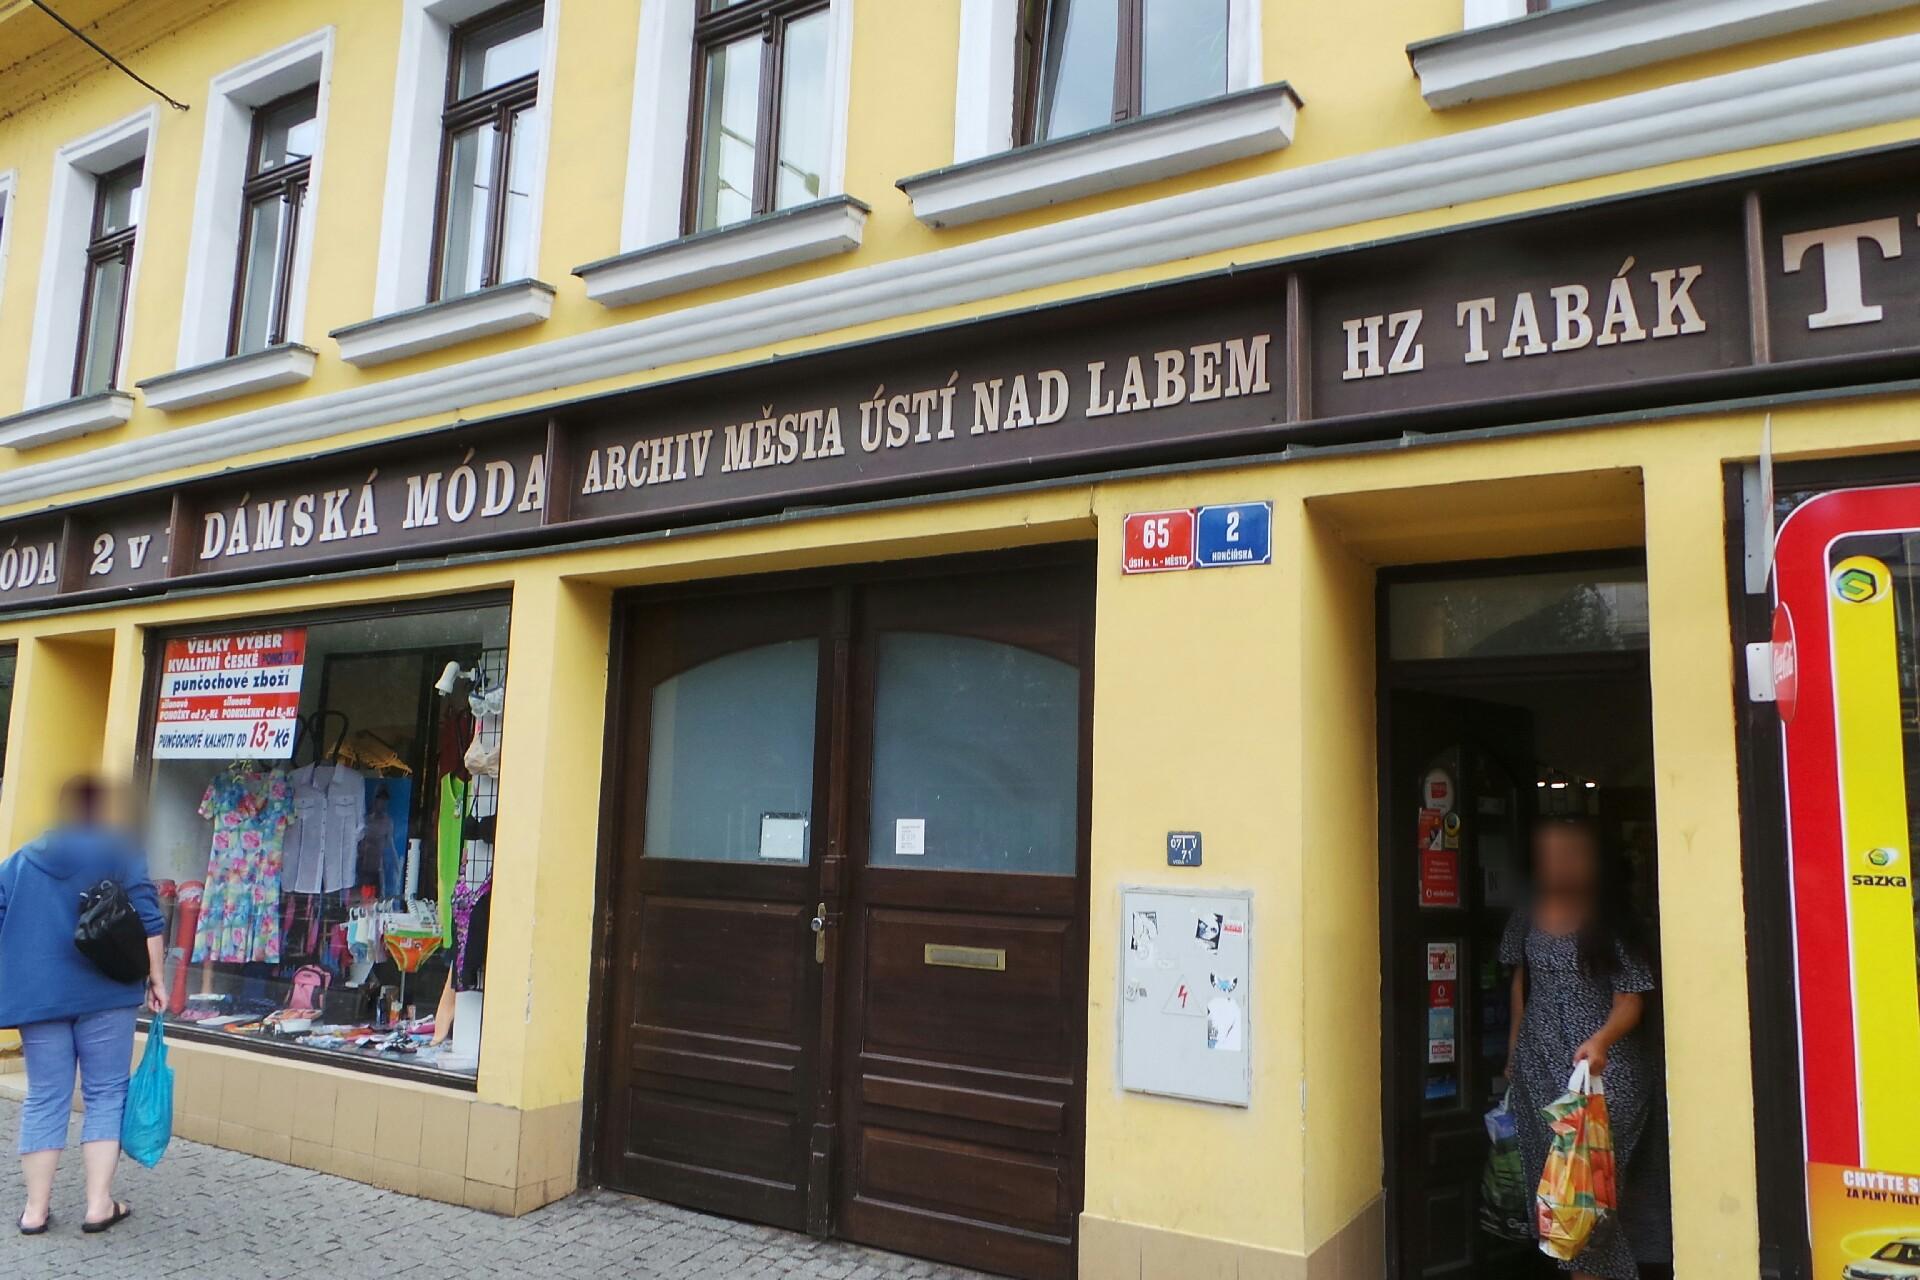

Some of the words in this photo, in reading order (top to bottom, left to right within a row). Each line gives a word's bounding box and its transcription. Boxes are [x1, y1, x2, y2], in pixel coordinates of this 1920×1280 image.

[1782, 212, 1920, 331] T
[1342, 308, 1424, 381] HZ
[1456, 255, 1706, 364] TABÁK
[582, 429, 714, 495] ARCHIV
[721, 403, 846, 474] MĚSTA
[859, 370, 960, 452] ÚSTÍ
[970, 369, 1070, 436] NAD
[1086, 334, 1271, 418] LABEM
[200, 466, 379, 560] DÁMSKÁ
[402, 448, 545, 530] MÓDA
[1143, 518, 1170, 549] 65
[1226, 511, 1240, 542] 2
[90, 532, 115, 576] 2
[1128, 556, 1144, 569] ÚSTÍ
[1152, 557, 1159, 567] L.
[1164, 555, 1188, 567] MĚSTO
[1212, 547, 1253, 562] HRNČÍŘSKÁ
[167, 654, 221, 673] KVALITNÍ
[224, 650, 259, 669] ČESKÉ
[172, 671, 249, 695] punčochové
[252, 668, 291, 688] zboží
[191, 709, 201, 719] od
[222, 707, 266, 719] PODKOLENKY
[266, 706, 276, 718] od
[158, 730, 203, 748] PUNČOCHOVÉ
[204, 732, 236, 748] KALHOTY
[237, 732, 247, 747] OD
[1852, 874, 1907, 887] sazka
[1843, 1169, 1905, 1193] CHYŤTE
[1846, 1187, 1859, 1199] ZA
[1890, 1192, 1920, 1206] TIKET
